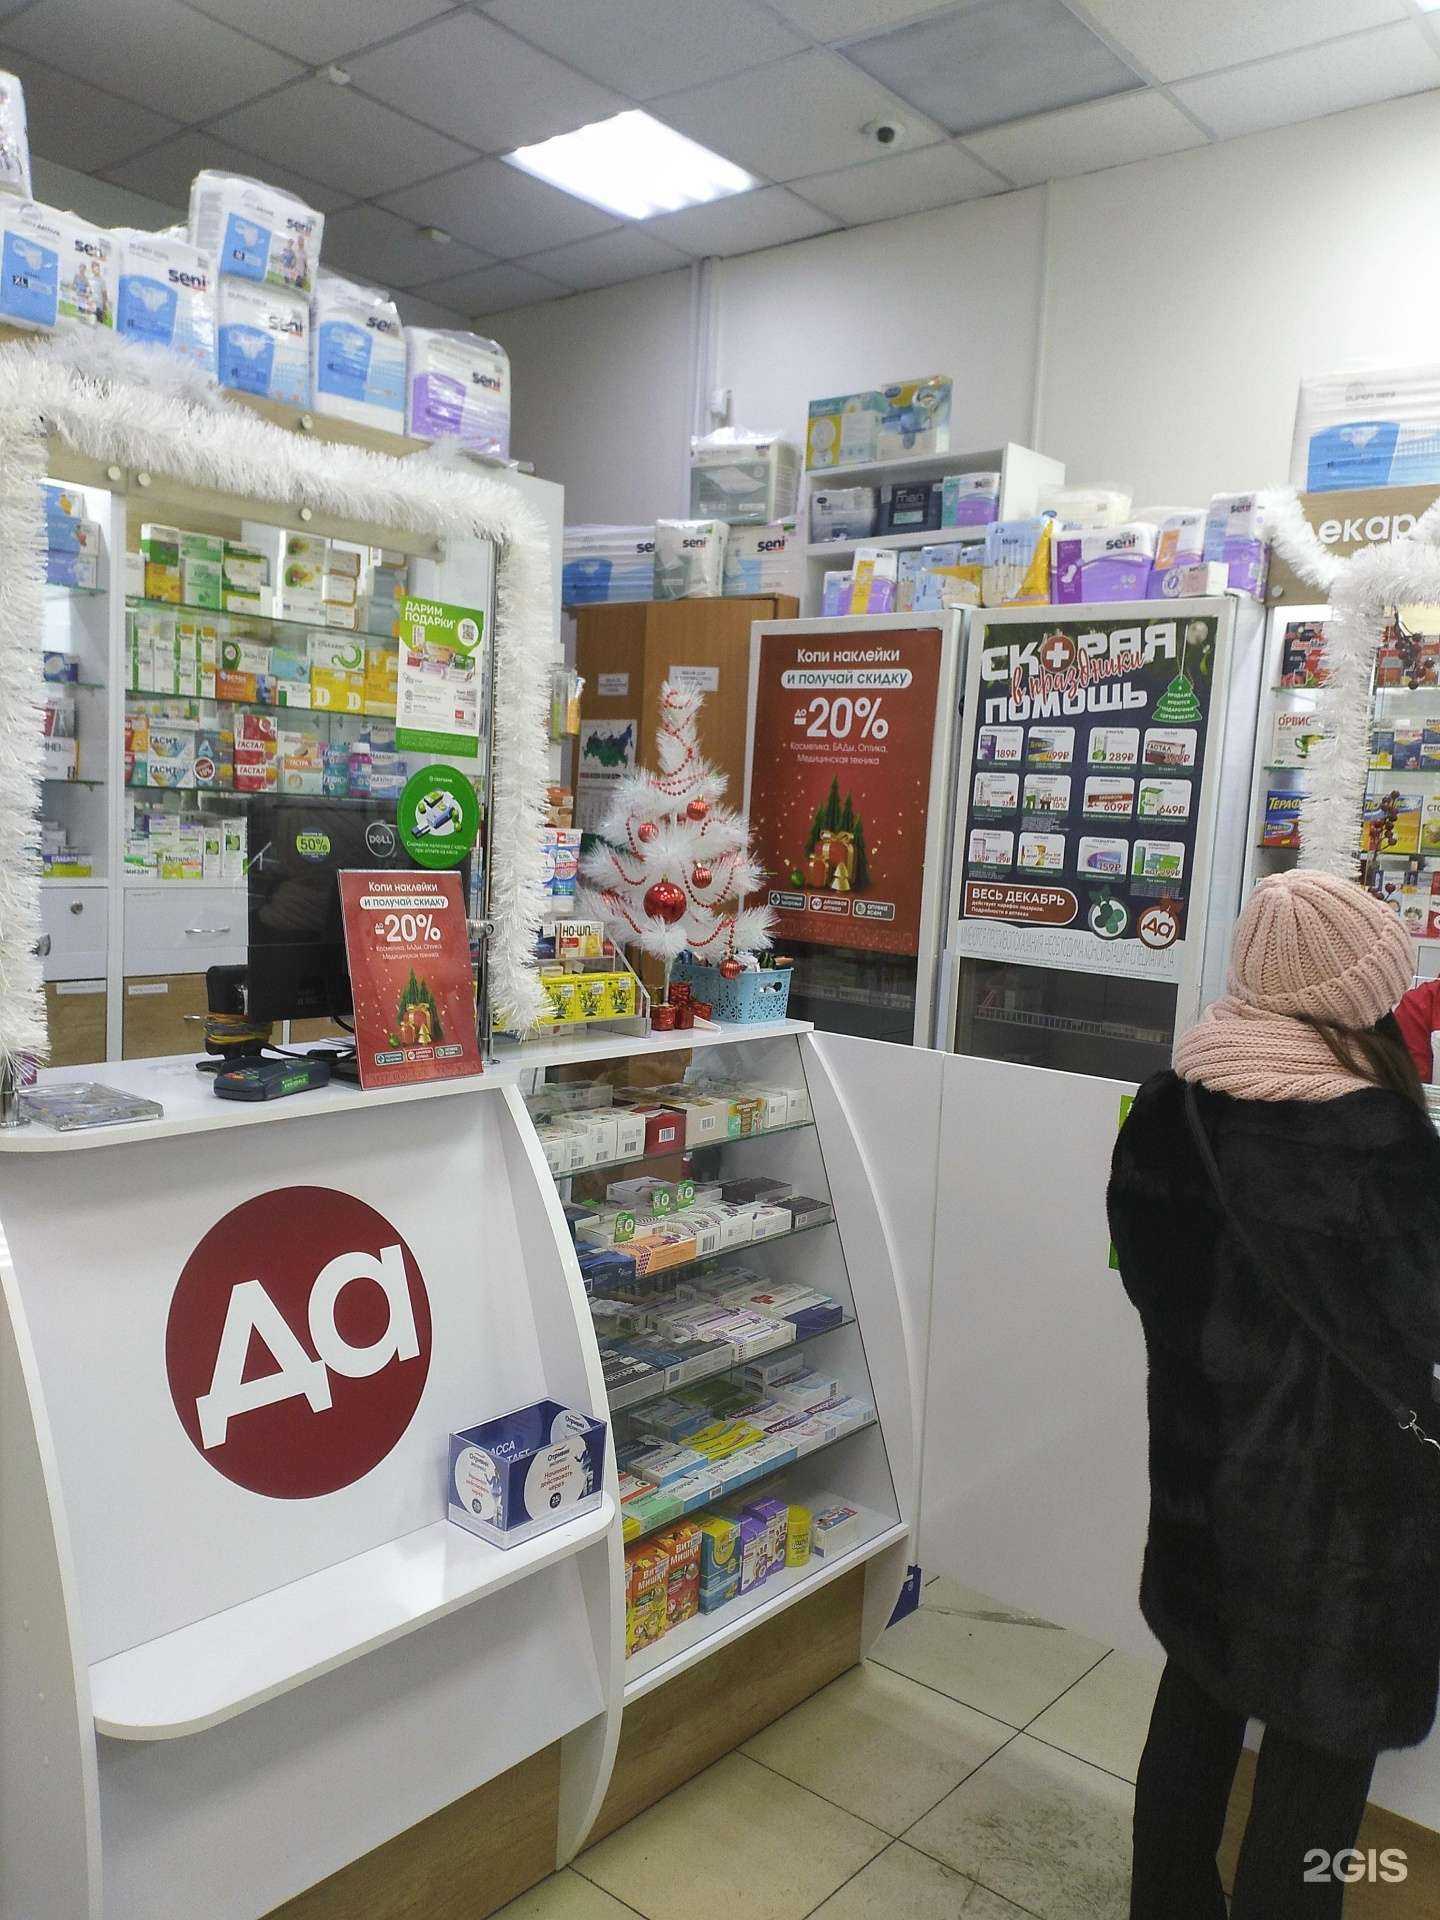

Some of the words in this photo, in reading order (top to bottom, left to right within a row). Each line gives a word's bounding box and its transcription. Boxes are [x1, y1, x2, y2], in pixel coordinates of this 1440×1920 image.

[168, 268, 208, 289] seni
[682, 537, 708, 549] seni
[757, 533, 786, 552] seni
[1106, 534, 1137, 551] seni
[405, 600, 443, 617] ДАРИМ
[797, 649, 830, 662] Копи
[833, 647, 901, 662] наклейки
[787, 674, 795, 683] и
[799, 671, 853, 687] получай
[857, 673, 908, 687] скидку
[984, 682, 1148, 724] ПОМОЩЬ
[237, 740, 265, 750] ГАСТАЛ
[240, 766, 266, 776] ГАСТАЛ
[300, 838, 328, 851] 50%
[368, 834, 393, 845] DELL
[368, 881, 393, 893] Копи
[394, 881, 438, 893] наклейки
[373, 898, 412, 908] получай
[413, 898, 446, 908] скидку
[972, 888, 1004, 900] ВЕСЬ
[1005, 890, 1066, 907] ДЕКАБРЬ
